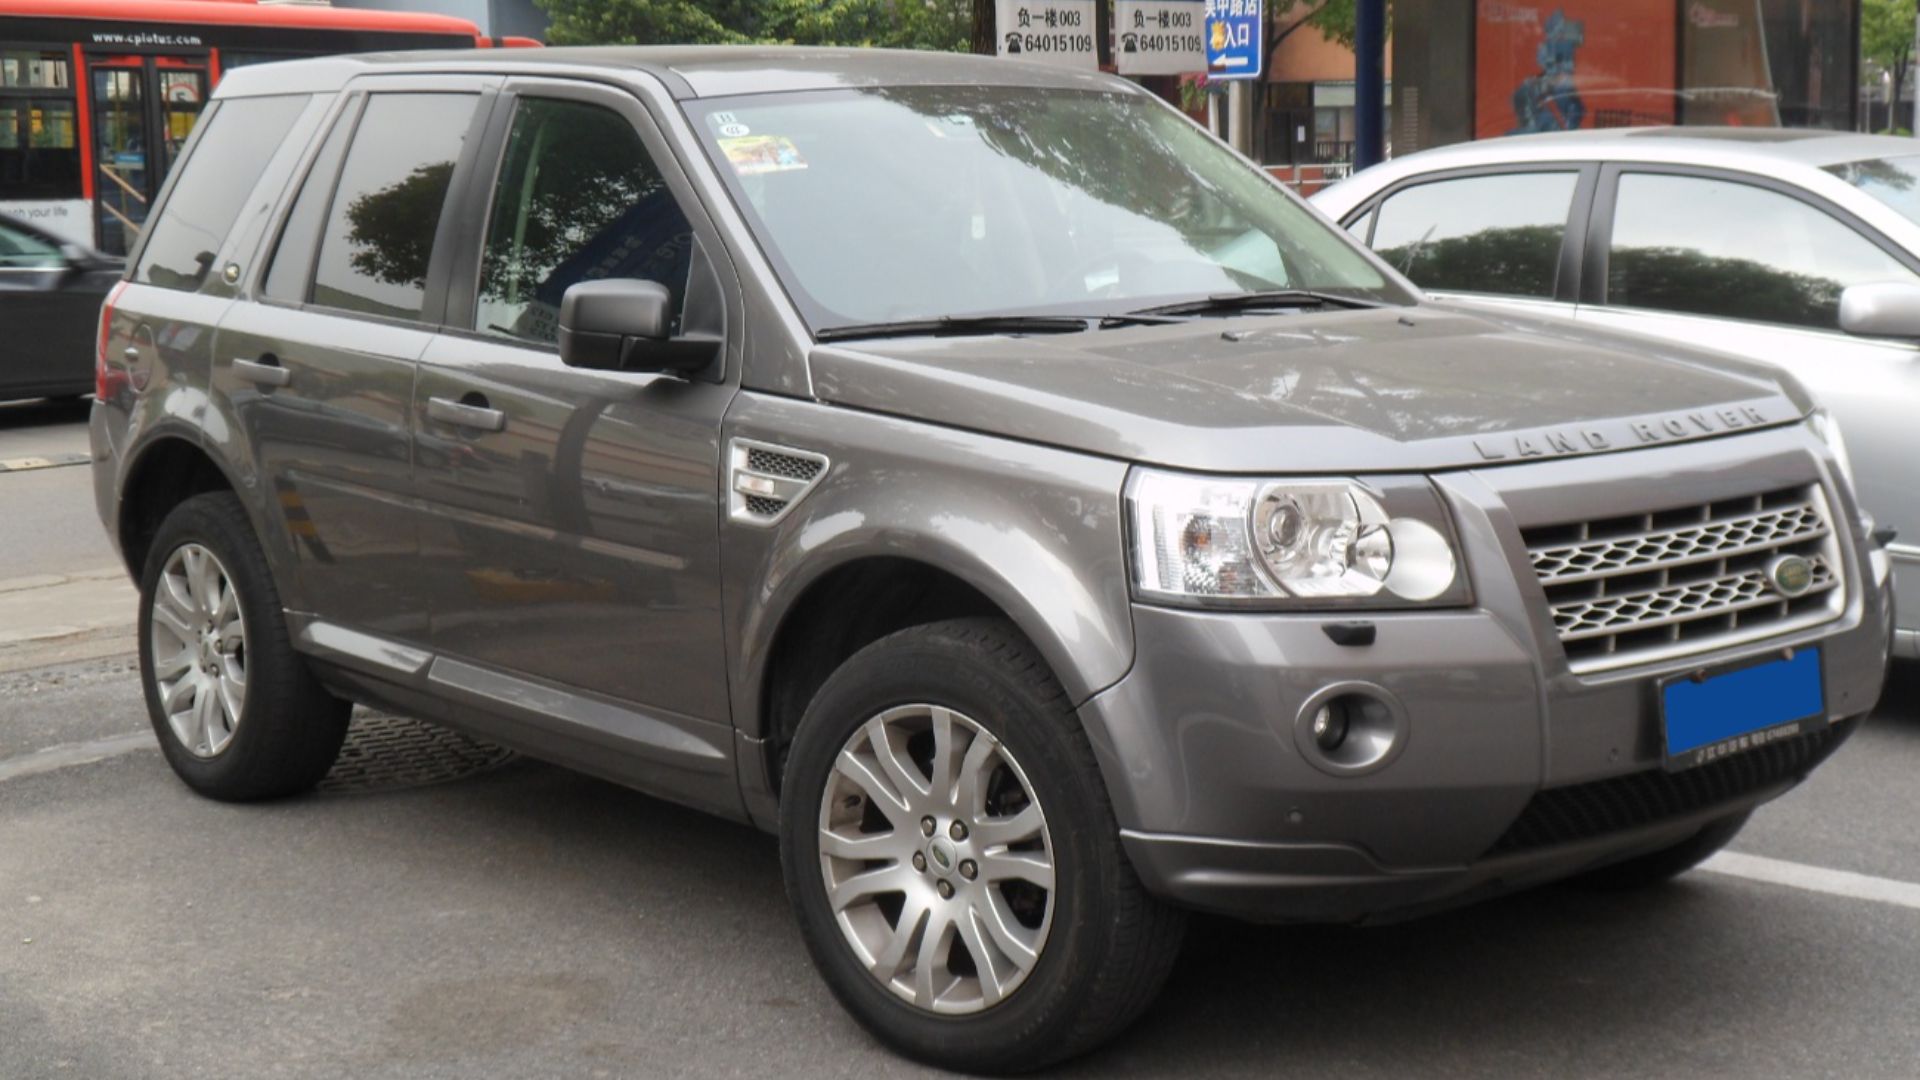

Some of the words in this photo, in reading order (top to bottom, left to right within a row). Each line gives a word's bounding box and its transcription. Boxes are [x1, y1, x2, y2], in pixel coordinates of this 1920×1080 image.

[1025, 34, 1092, 52] 64015109
[1140, 34, 1202, 52] 64015109
[1210, 21, 1249, 49] 入口
[28, 208, 51, 219] your
[53, 206, 68, 217] life
[1473, 430, 1610, 460] LAND
[1631, 406, 1767, 442] ROVER
